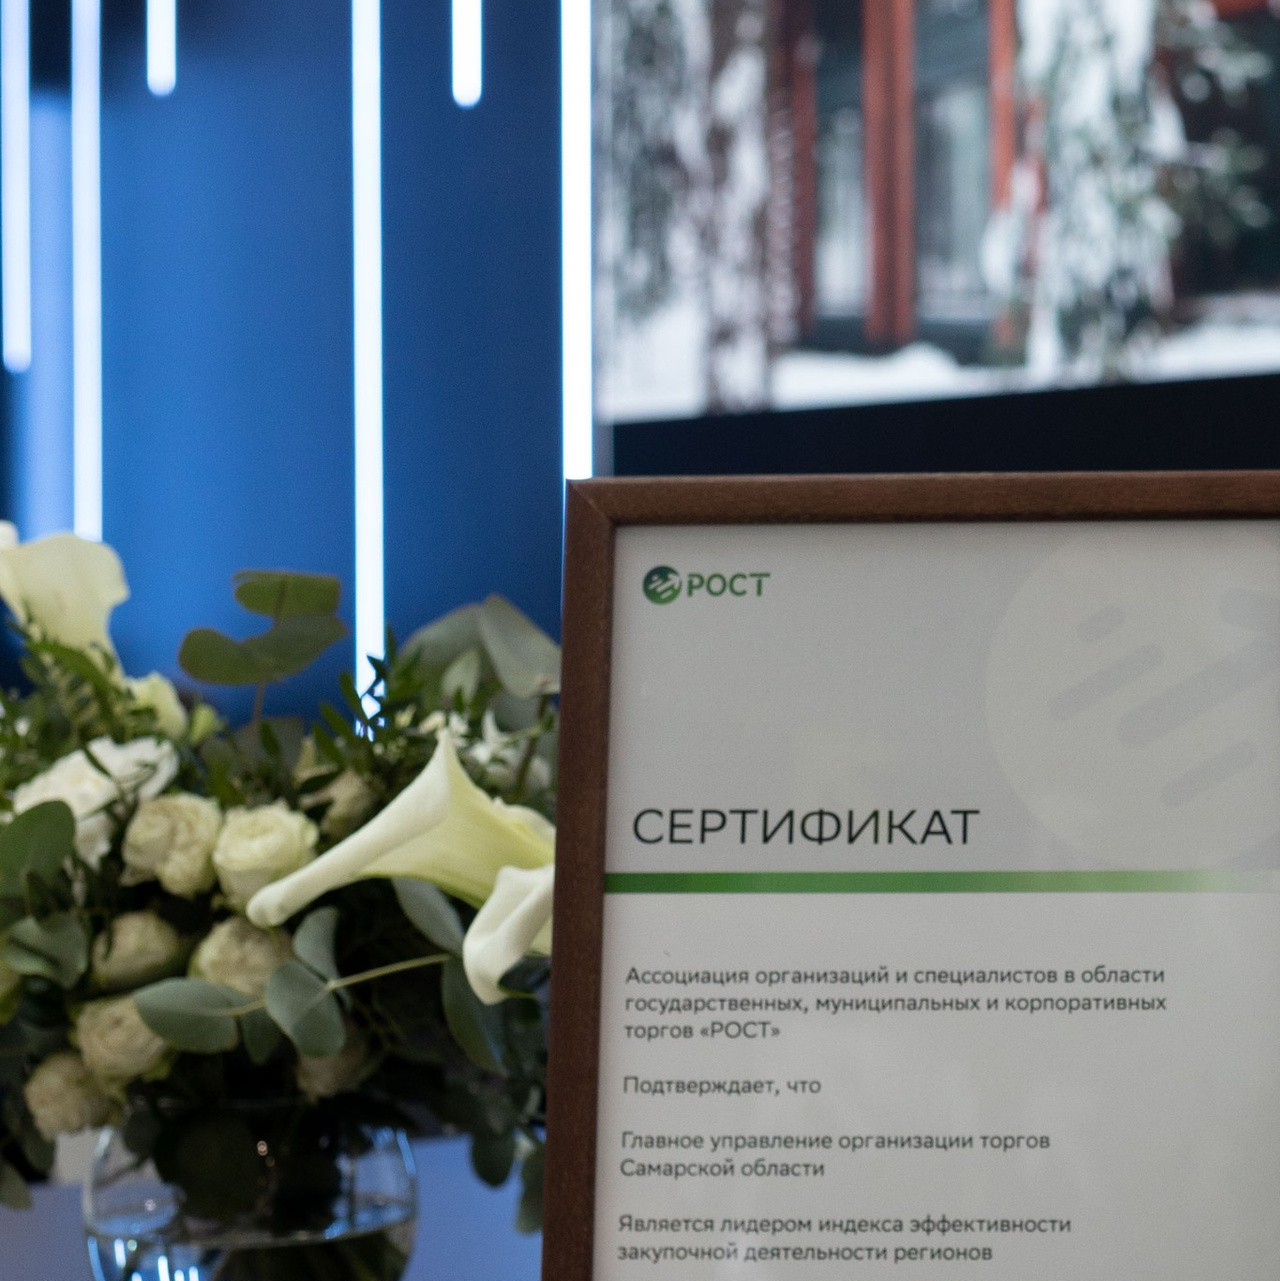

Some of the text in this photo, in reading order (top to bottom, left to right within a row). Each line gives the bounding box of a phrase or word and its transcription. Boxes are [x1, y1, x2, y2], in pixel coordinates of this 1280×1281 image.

[686, 572, 771, 598] РОСТ
[632, 808, 981, 846] СЕРТИФИКАТ
[625, 964, 1165, 987] Ассоциация организаций и специалистов в области
[624, 997, 1167, 1016] государственных, муниципальных и корпоративных
[623, 1019, 781, 1042] торгов «РОСТ»
[622, 1075, 822, 1097] Подтверждает, что
[621, 1130, 1051, 1153] Главное управление организации торгов
[619, 1157, 825, 1180] Самарской области
[618, 1213, 1072, 1236] Является лидером индекса эффективности
[617, 1242, 993, 1265] закупочной деятельности регионов
